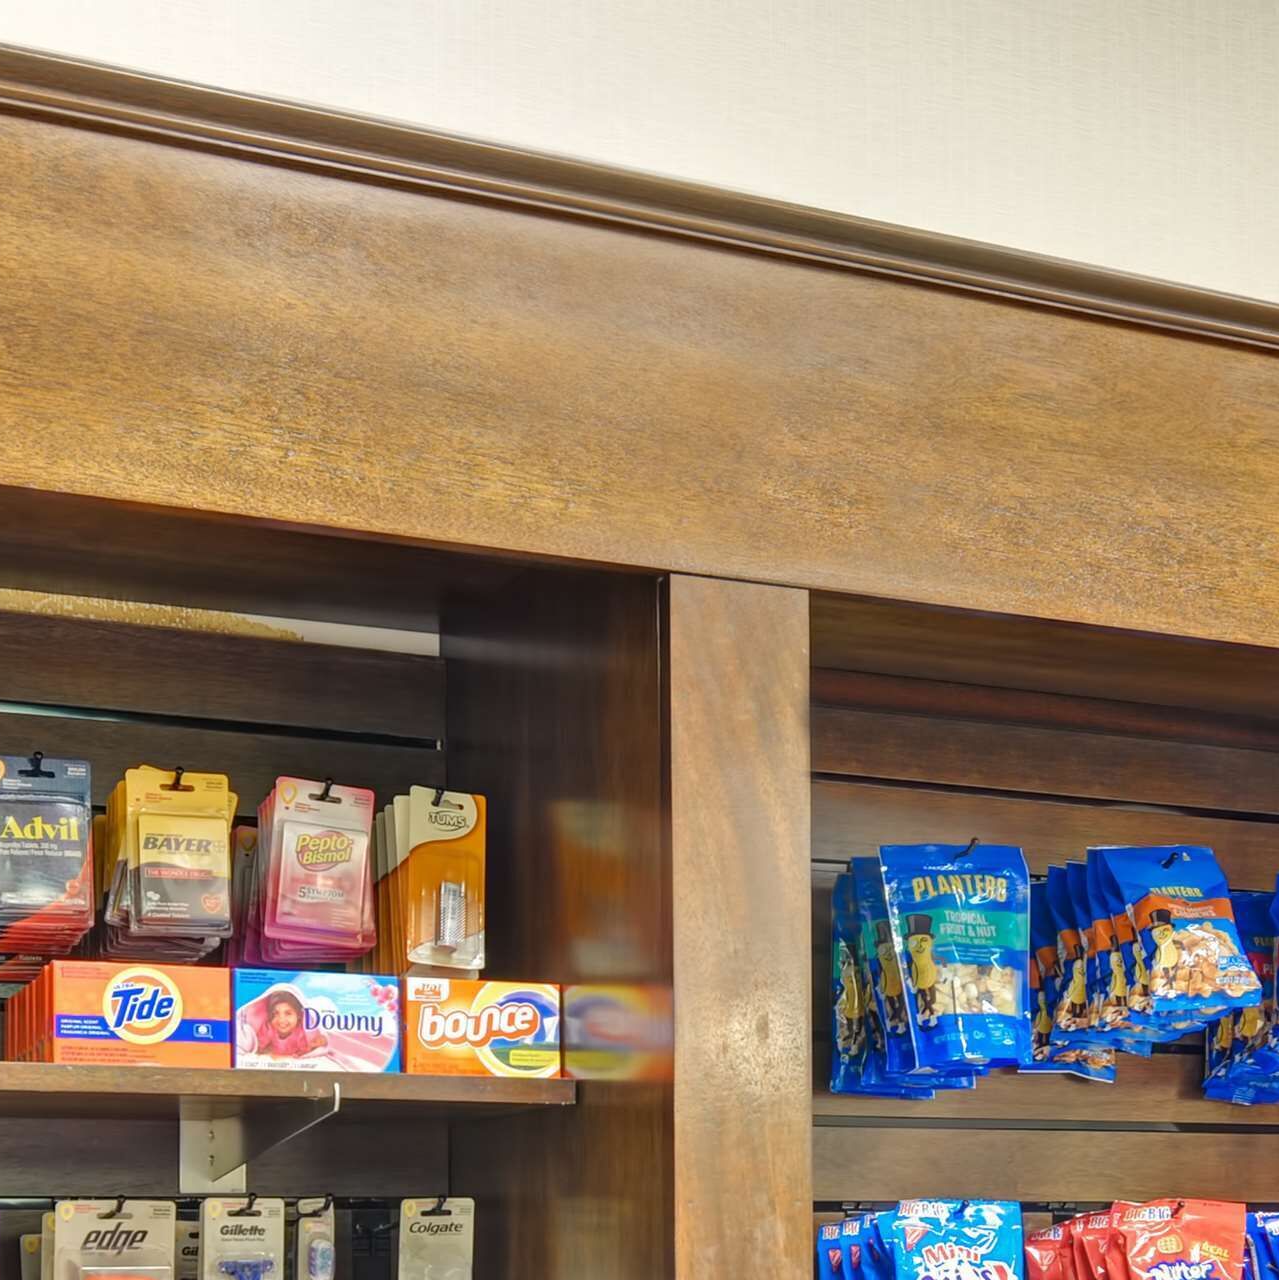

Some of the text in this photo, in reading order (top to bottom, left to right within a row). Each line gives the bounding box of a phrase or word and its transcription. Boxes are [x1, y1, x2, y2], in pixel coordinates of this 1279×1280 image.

[0, 815, 81, 841] Advil
[428, 811, 467, 828] TUMS
[143, 836, 212, 852] BAYER
[302, 849, 352, 866] Bismol
[943, 909, 989, 926] TROPICAL
[939, 923, 966, 937] FRUIT
[976, 925, 997, 938] NUT
[111, 988, 175, 1029] Tide
[304, 1007, 384, 1036] Downy
[420, 1003, 538, 1046] bounce
[219, 1224, 266, 1237] Gillette
[409, 1221, 464, 1236] Colgate
[81, 1222, 149, 1256] edge
